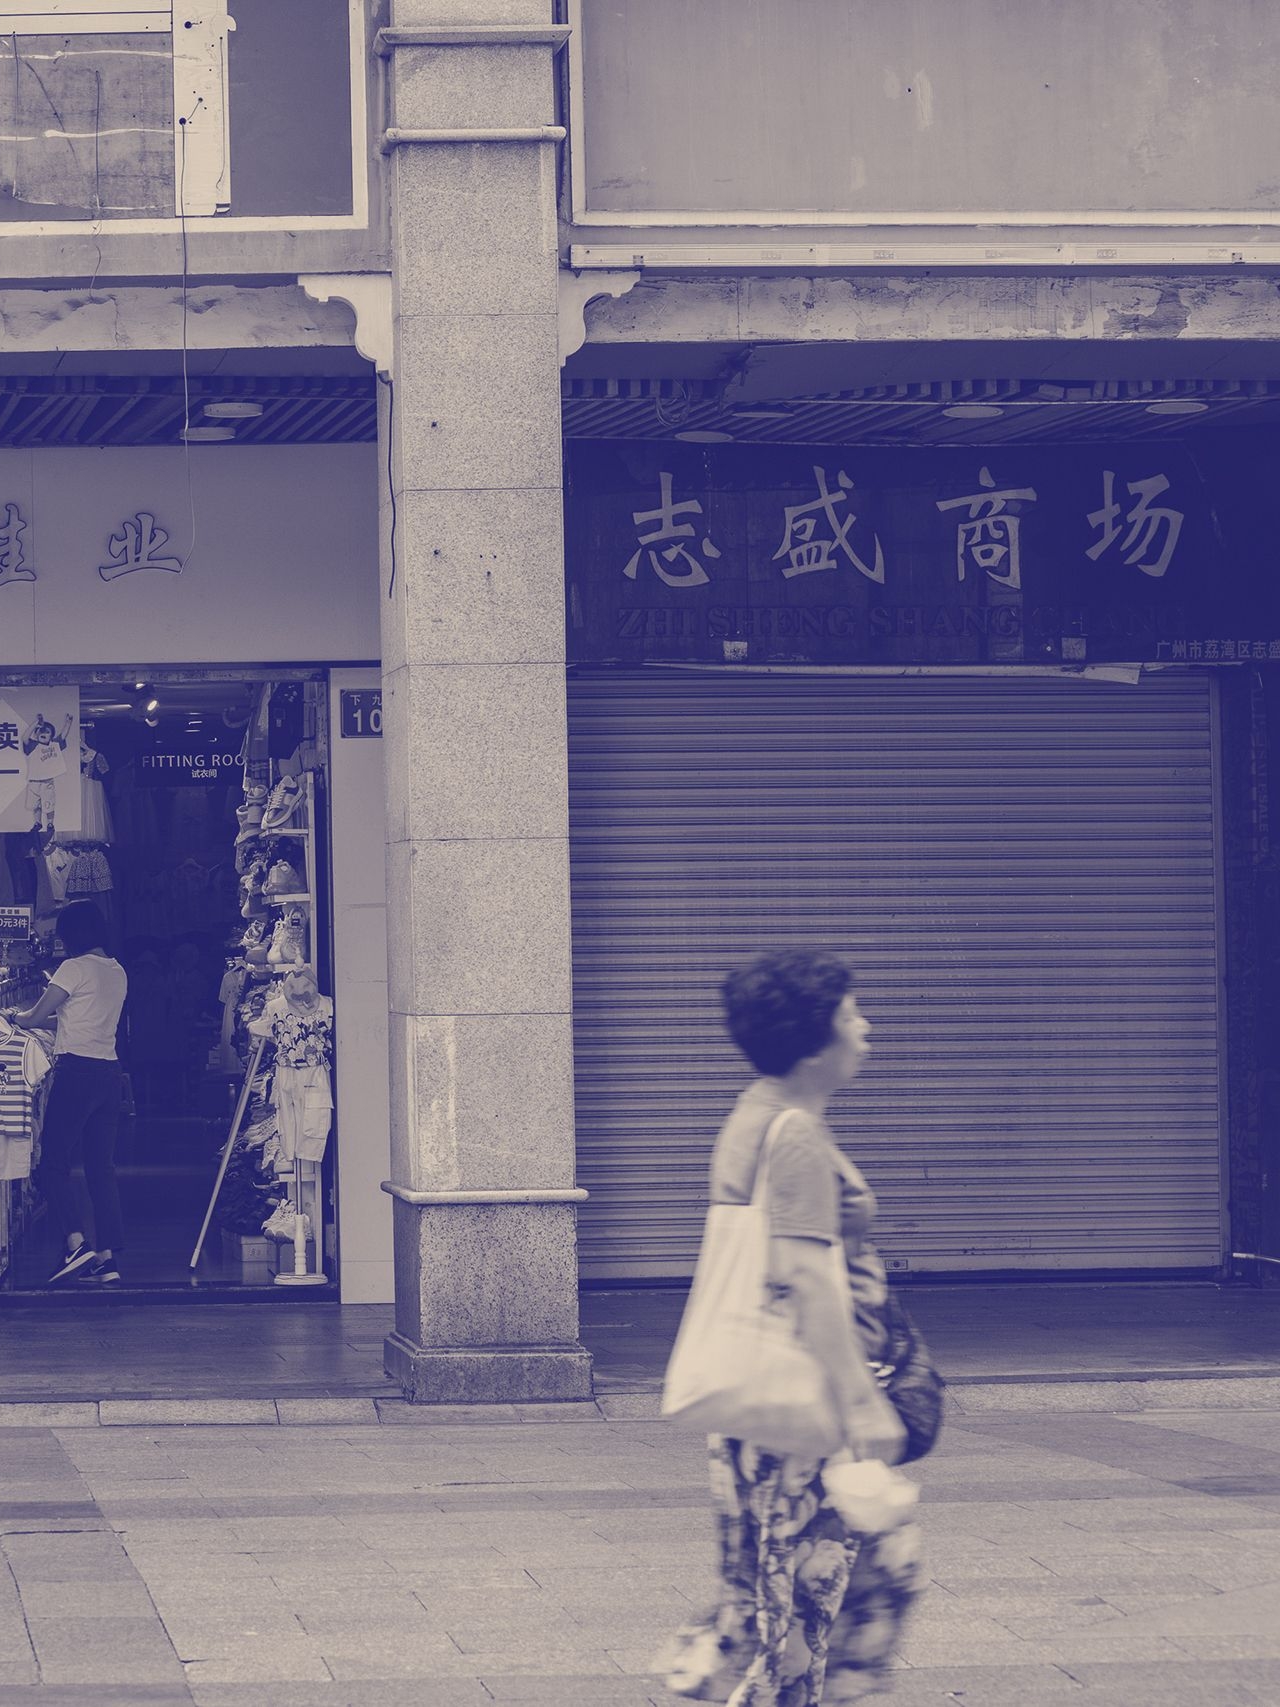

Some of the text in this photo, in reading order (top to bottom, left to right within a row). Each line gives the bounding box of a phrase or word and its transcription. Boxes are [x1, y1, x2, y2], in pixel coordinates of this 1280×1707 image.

[622, 466, 1185, 589] 志盛商场
[618, 607, 697, 639] ZHI
[707, 606, 857, 639] SHENG
[869, 606, 1022, 639] SHANG
[142, 754, 205, 768] FITTING
[191, 768, 218, 779] 试衣间
